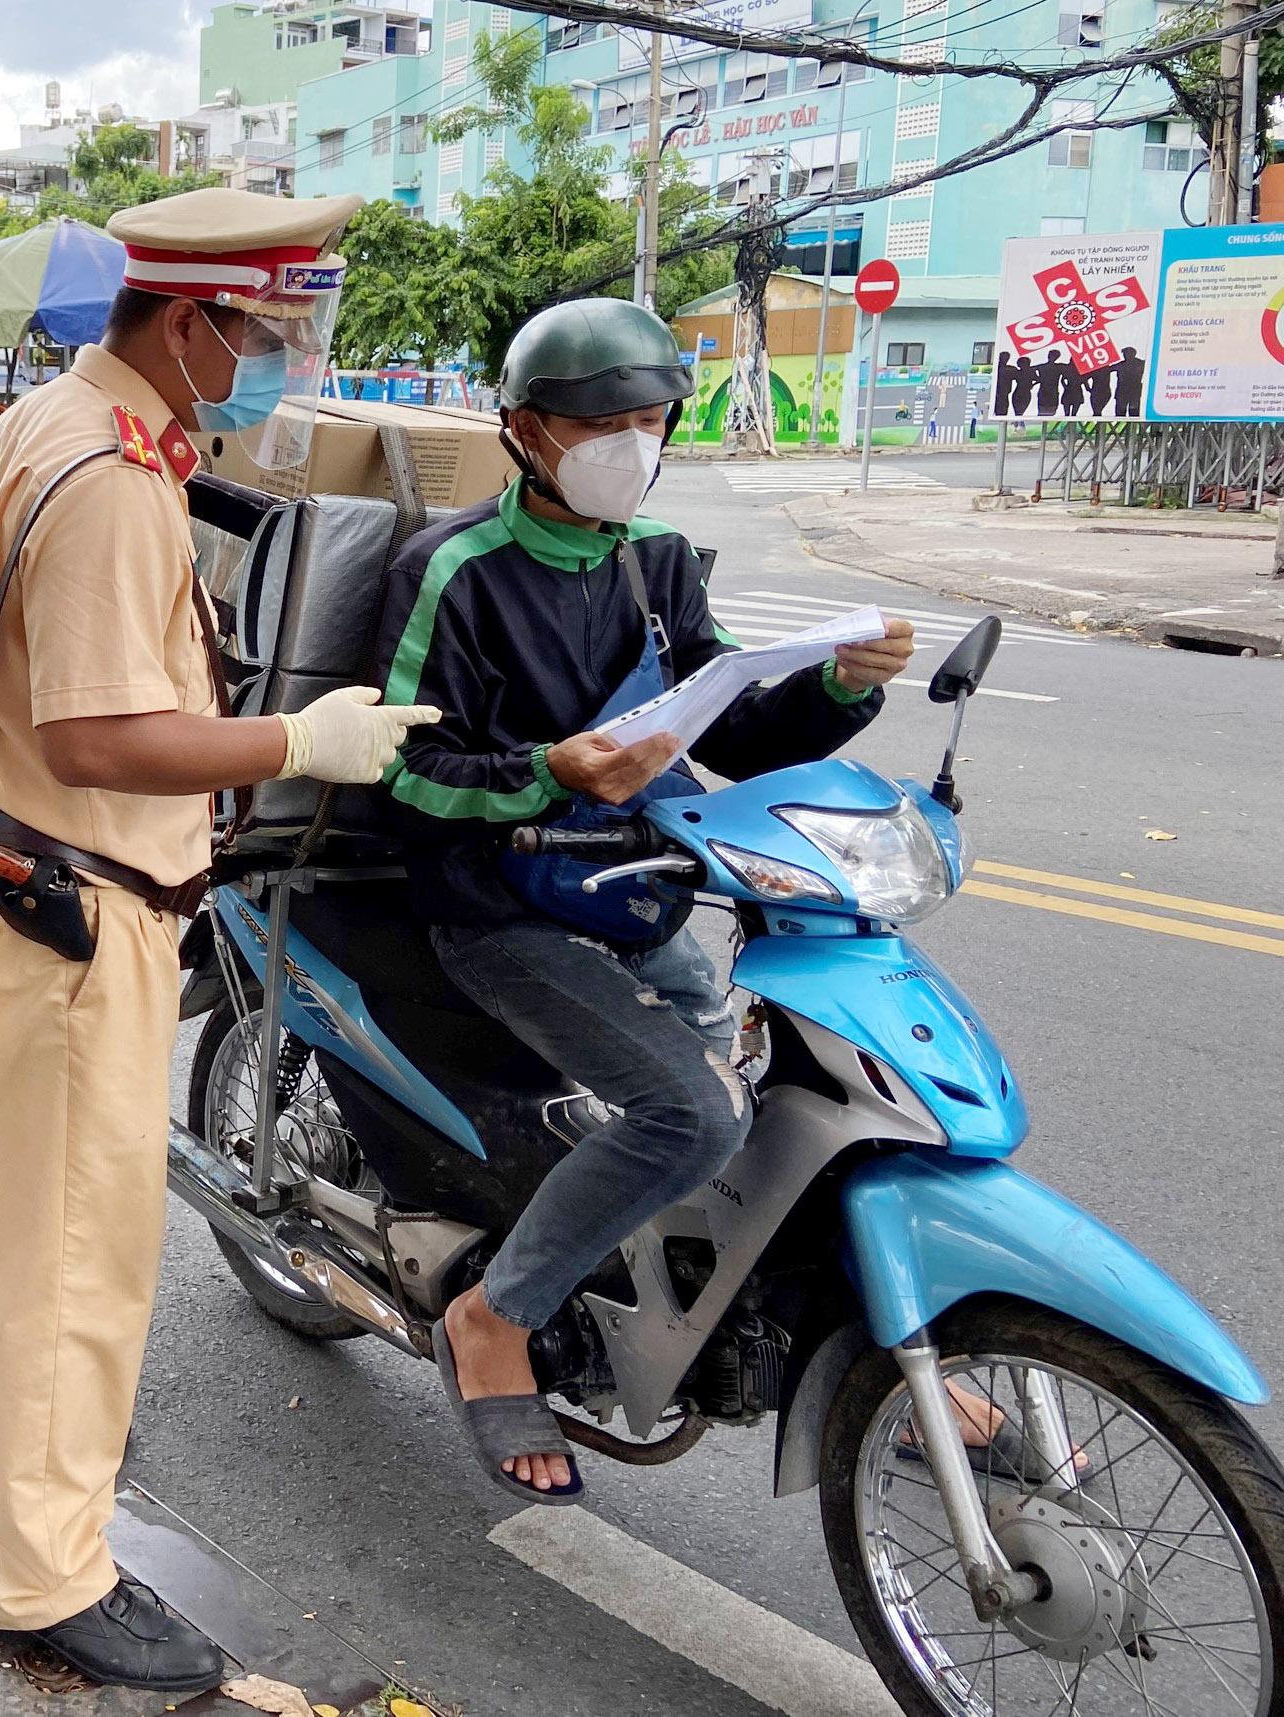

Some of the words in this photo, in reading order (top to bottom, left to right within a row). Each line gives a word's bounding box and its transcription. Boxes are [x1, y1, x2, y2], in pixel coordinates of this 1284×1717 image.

[723, 115, 753, 142] HẬU
[756, 112, 786, 137] HỌC
[789, 104, 820, 128] VĂN
[1227, 234, 1261, 245] CHUNG
[1103, 246, 1123, 254] ĐÔNG
[1125, 244, 1150, 252] NGƯỜI
[1090, 256, 1114, 264] TRÁNH
[1082, 265, 1102, 276] LÂY
[1103, 262, 1135, 274] NHIỄM
[1178, 264, 1198, 273] KHẨU
[1200, 264, 1226, 273] TRANG
[1046, 277, 1077, 304] C
[1172, 318, 1204, 326] KHOẢNG
[1205, 318, 1225, 326] CÁCH
[1081, 347, 1110, 369] 19
[1167, 369, 1185, 377] KHAI
[1187, 369, 1202, 377] BÁO
[1210, 368, 1219, 376] TẾ
[1165, 392, 1178, 400] App
[1180, 391, 1202, 399] NCOVI
